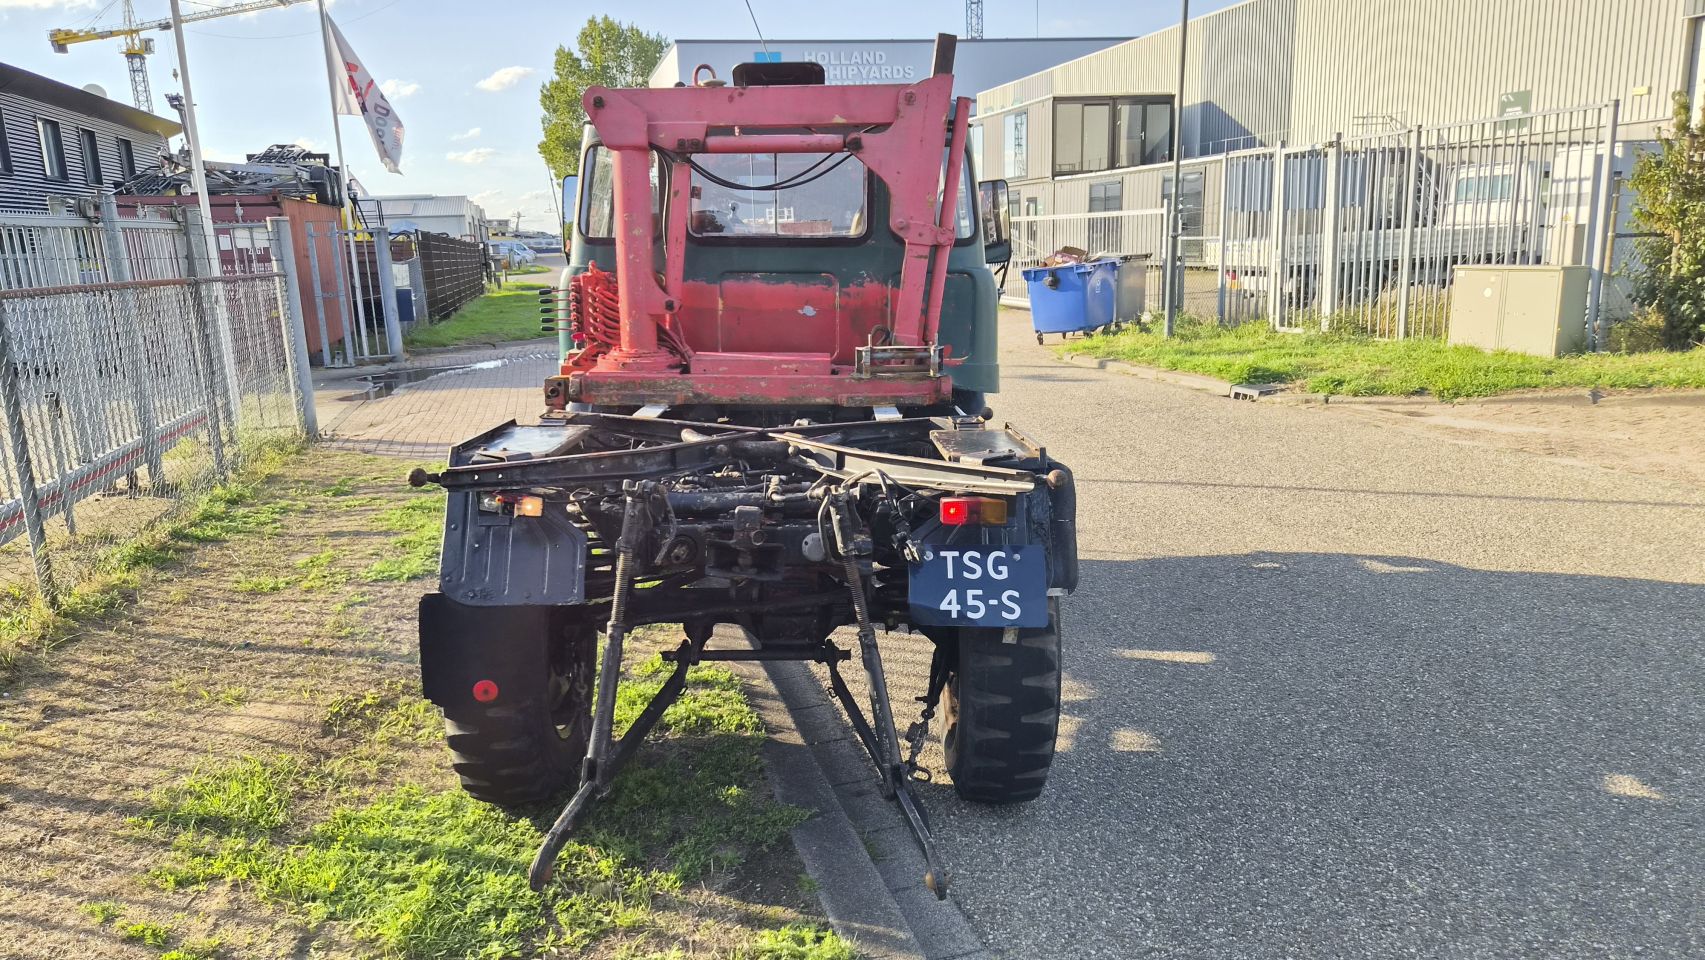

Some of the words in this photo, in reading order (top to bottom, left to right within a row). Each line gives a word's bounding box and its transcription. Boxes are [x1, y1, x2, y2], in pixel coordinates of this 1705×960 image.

[803, 51, 887, 65] HOLLAND
[826, 66, 915, 80] HIPYARDS
[940, 551, 1009, 580] TSG
[940, 589, 1021, 620] 45-S
